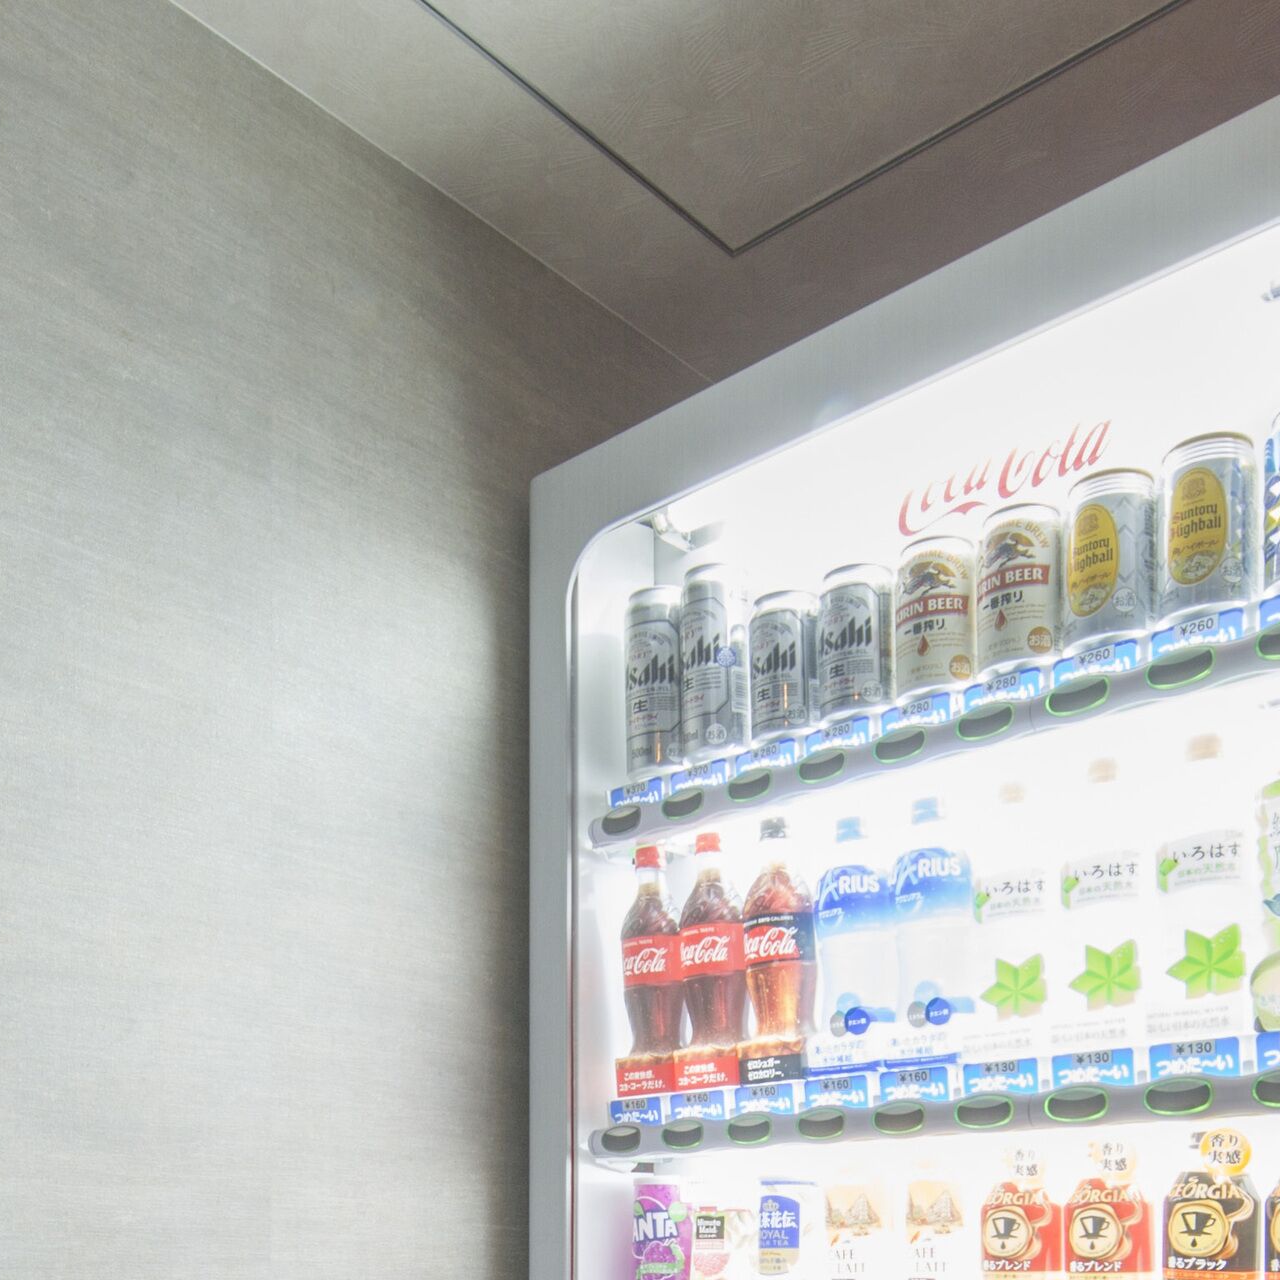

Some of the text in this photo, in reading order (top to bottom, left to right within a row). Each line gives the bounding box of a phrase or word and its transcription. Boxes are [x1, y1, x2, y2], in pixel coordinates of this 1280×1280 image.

[1006, 568, 1043, 583] BEER
[928, 598, 963, 611] BEER
[983, 591, 1024, 610] 一番搾り
[904, 619, 945, 635] 一番搾り
[1180, 620, 1214, 636] ¥260
[819, 617, 871, 657] sahi
[752, 640, 796, 674] sahi
[1079, 649, 1111, 665] ¥260
[626, 654, 675, 690] sahi
[829, 663, 845, 679] 生
[986, 676, 1017, 692] ¥280
[757, 687, 771, 701] 生
[633, 699, 648, 714] 生
[902, 702, 930, 716] ¥280
[824, 725, 850, 738] ¥280
[753, 745, 777, 758] ¥280
[1172, 841, 1241, 863] いろはす
[1074, 862, 1138, 881] いろはす
[985, 879, 1045, 897] いろはす
[1176, 1043, 1212, 1055] ¥130
[1076, 1052, 1109, 1065] ¥130
[984, 1062, 1015, 1073] ¥130
[899, 1071, 928, 1082] ¥160
[752, 1087, 776, 1097] ¥160
[823, 1080, 849, 1090] ¥160
[624, 1100, 646, 1110] ¥160
[686, 1093, 708, 1103] ¥160
[1210, 1133, 1238, 1147] 香り
[1208, 1149, 1241, 1164] 実感
[632, 1211, 678, 1242] ANTA
[759, 1211, 798, 1229] 茶花伝
[760, 1230, 789, 1239] OYAL
[1168, 1257, 1227, 1271] 香るブラック
